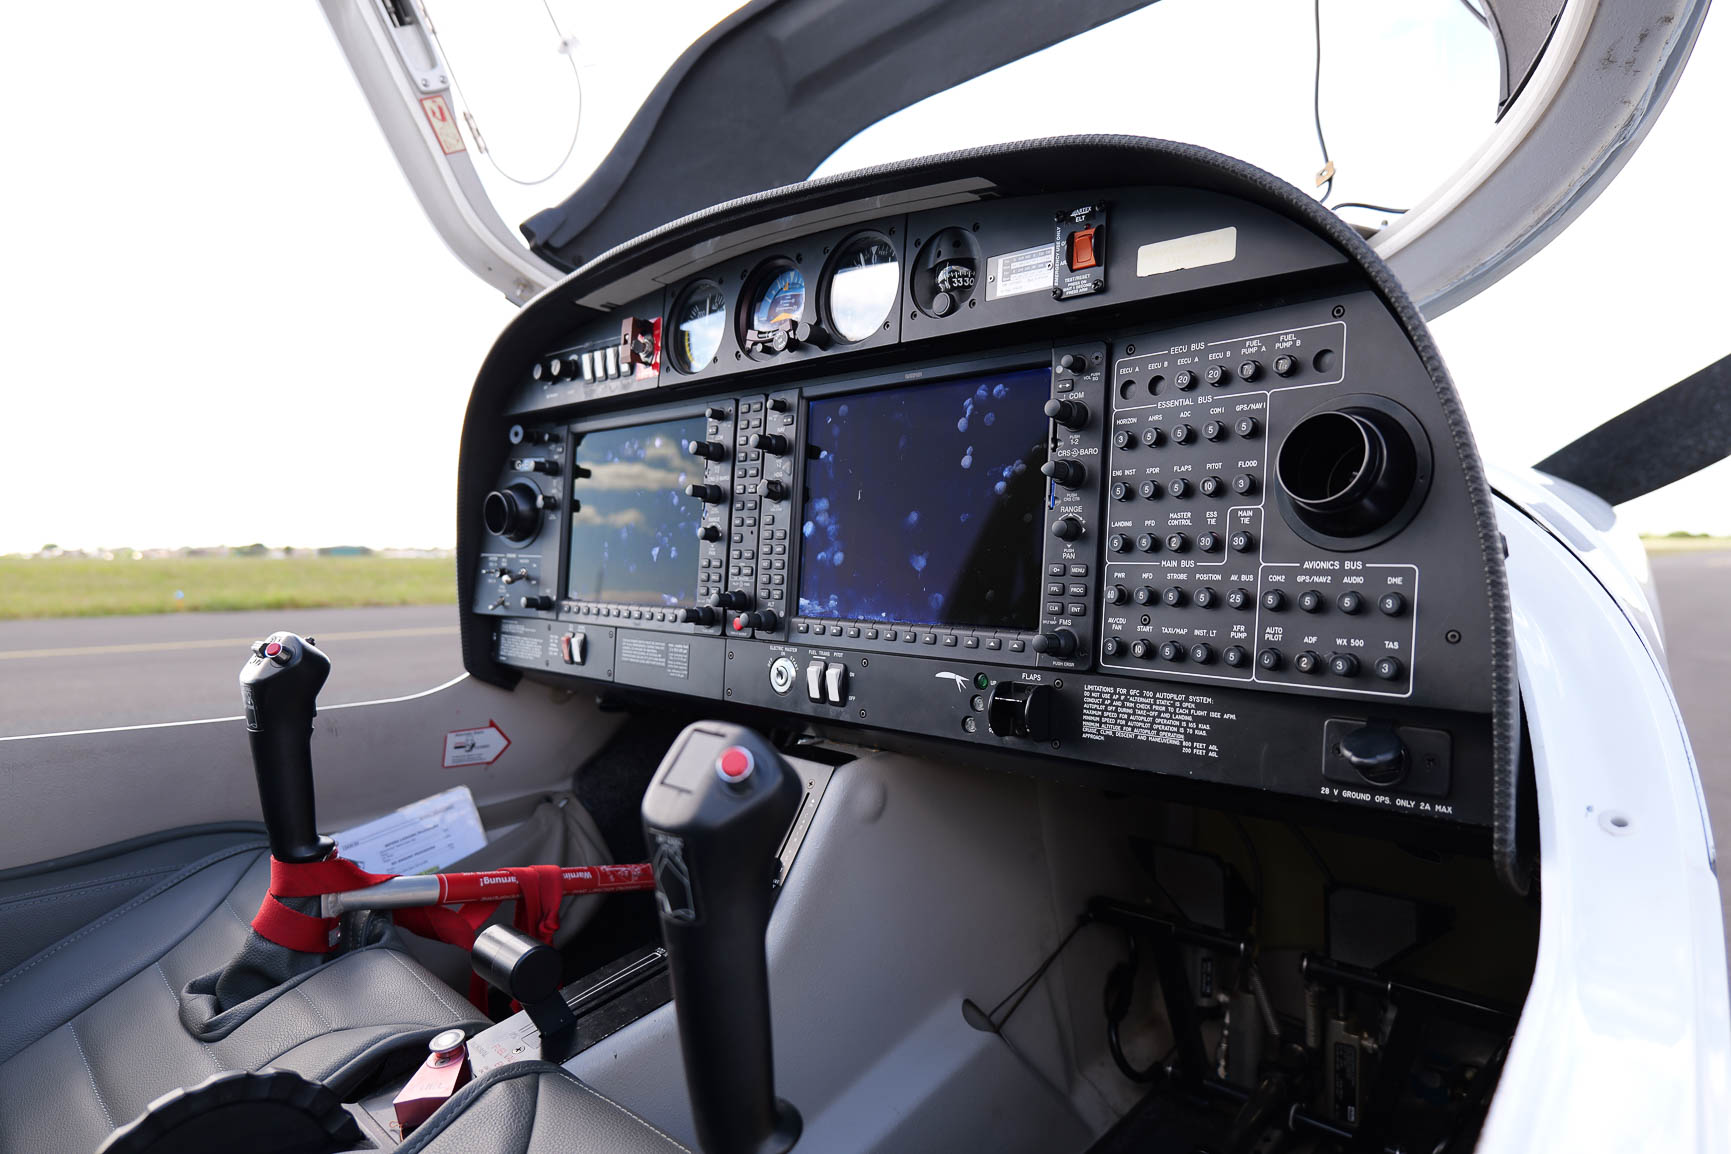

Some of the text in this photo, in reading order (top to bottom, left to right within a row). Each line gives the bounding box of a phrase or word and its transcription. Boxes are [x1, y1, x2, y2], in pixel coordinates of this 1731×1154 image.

[1170, 342, 1205, 354] EECU BUS
[1158, 395, 1212, 408] ESSENTIAL BUS
[1200, 537, 1211, 546] 30
[1233, 537, 1244, 545] 30
[1303, 561, 1363, 570] AVIONICS BUS
[1161, 627, 1188, 635] TAXI/MAP
[1134, 645, 1142, 653] 10
[1384, 641, 1399, 649] TAS
[1084, 684, 1114, 693] LIMITATIONS
[1156, 692, 1186, 700] AUTOPILOT
[1342, 790, 1371, 801] GROUND
[1375, 795, 1391, 805] OPS.
[1396, 798, 1415, 808] ONLY
[1420, 802, 1431, 811] 2A
[1435, 805, 1453, 814] MAX
[563, 871, 592, 879] Warnin
[480, 876, 519, 887] arnung!
